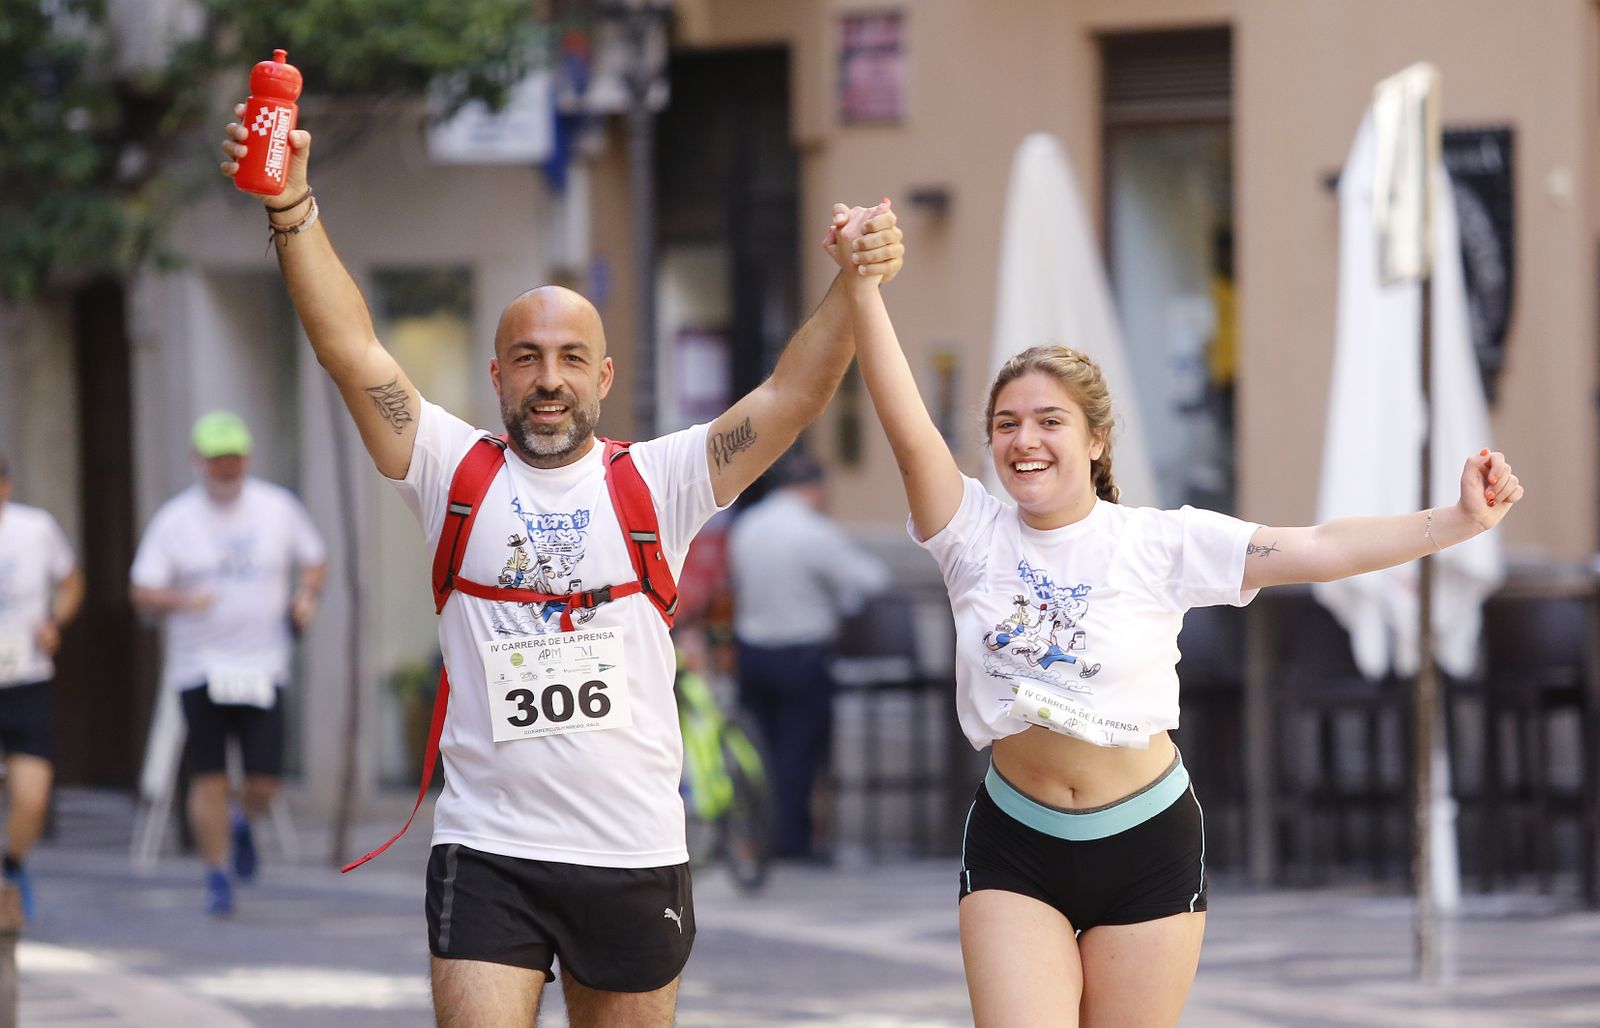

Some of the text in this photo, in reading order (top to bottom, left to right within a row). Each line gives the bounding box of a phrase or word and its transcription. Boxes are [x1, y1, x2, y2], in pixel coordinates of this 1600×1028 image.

[267, 107, 291, 170] NutriSport
[490, 631, 614, 652] IV CARRERA DE LA PRENSA
[504, 680, 611, 728] 306
[1024, 689, 1139, 732] IV CARRERA DE LA PRENSA
